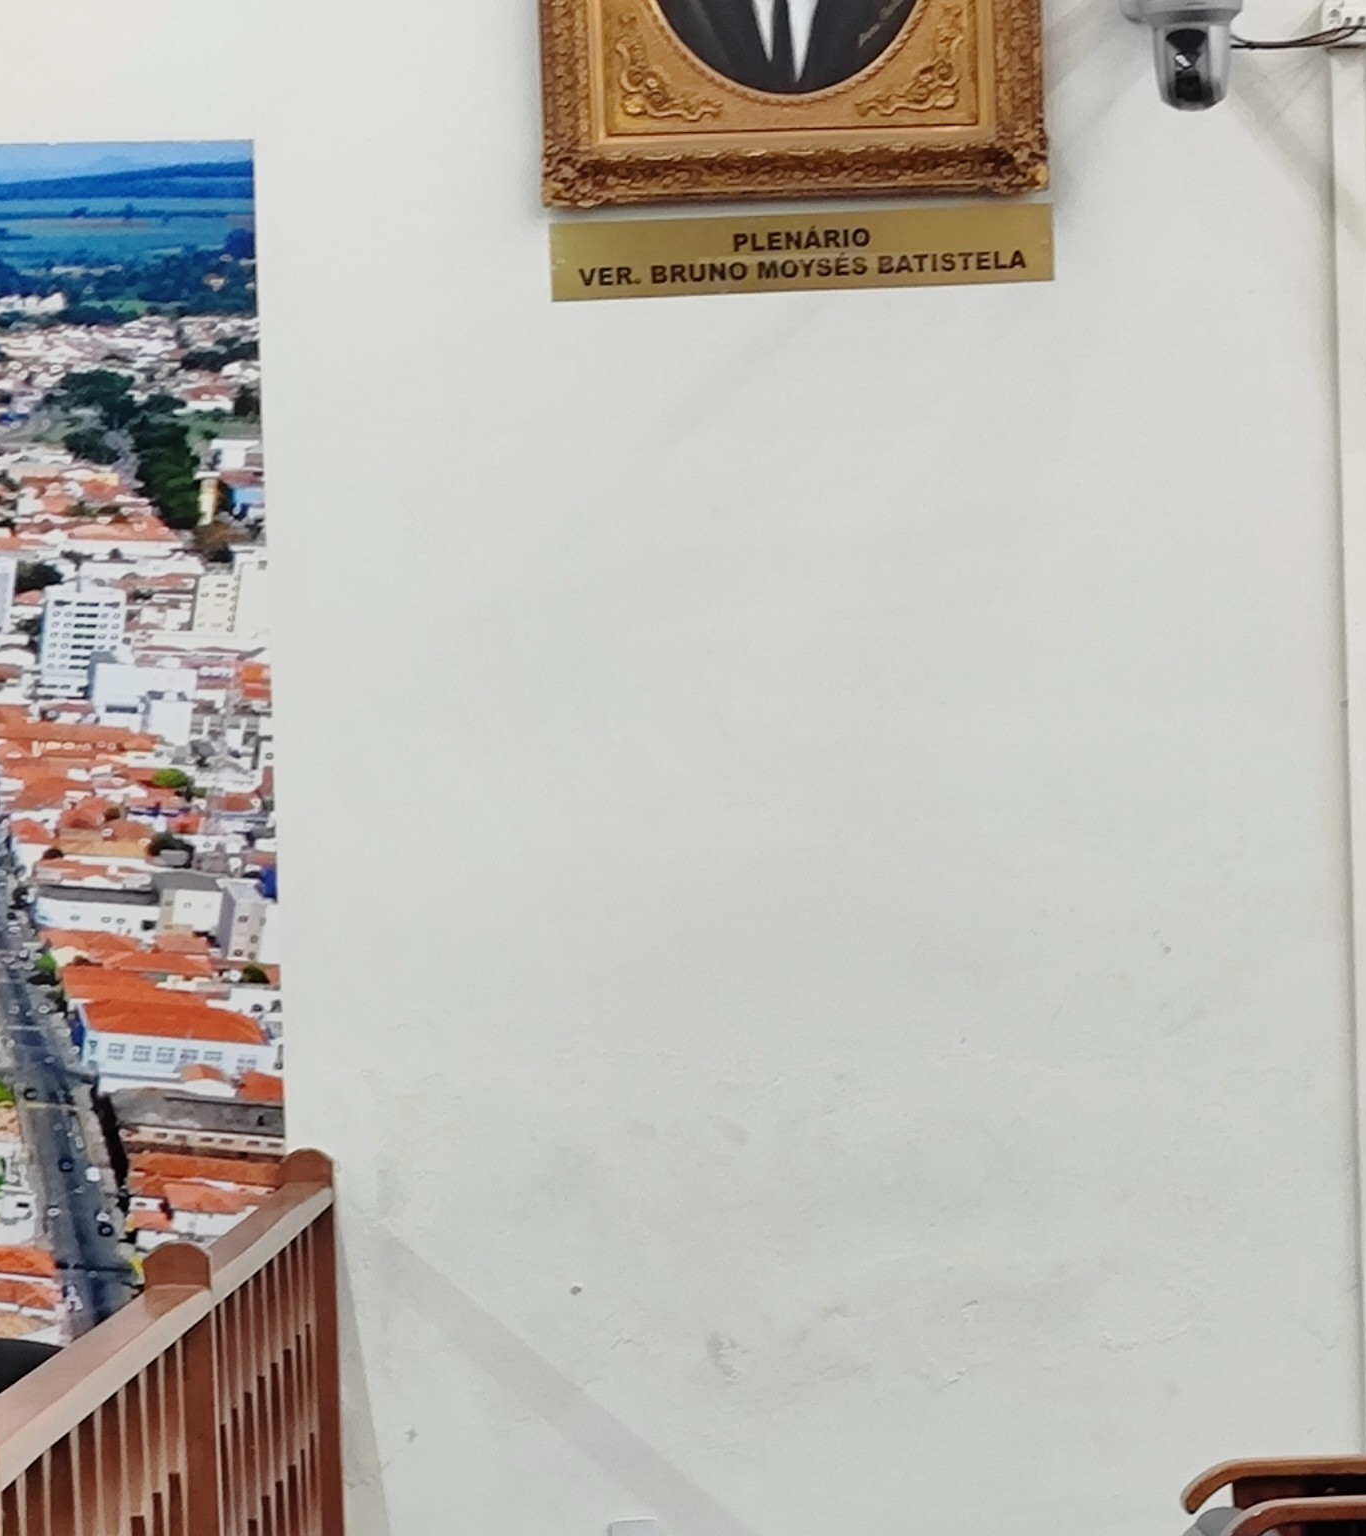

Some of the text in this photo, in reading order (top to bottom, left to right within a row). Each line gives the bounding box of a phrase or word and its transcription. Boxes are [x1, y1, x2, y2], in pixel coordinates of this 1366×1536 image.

[733, 226, 871, 252] PLENÁRIO
[579, 250, 1026, 286] VER. BRUNO MOYSÉS BATISTELA
